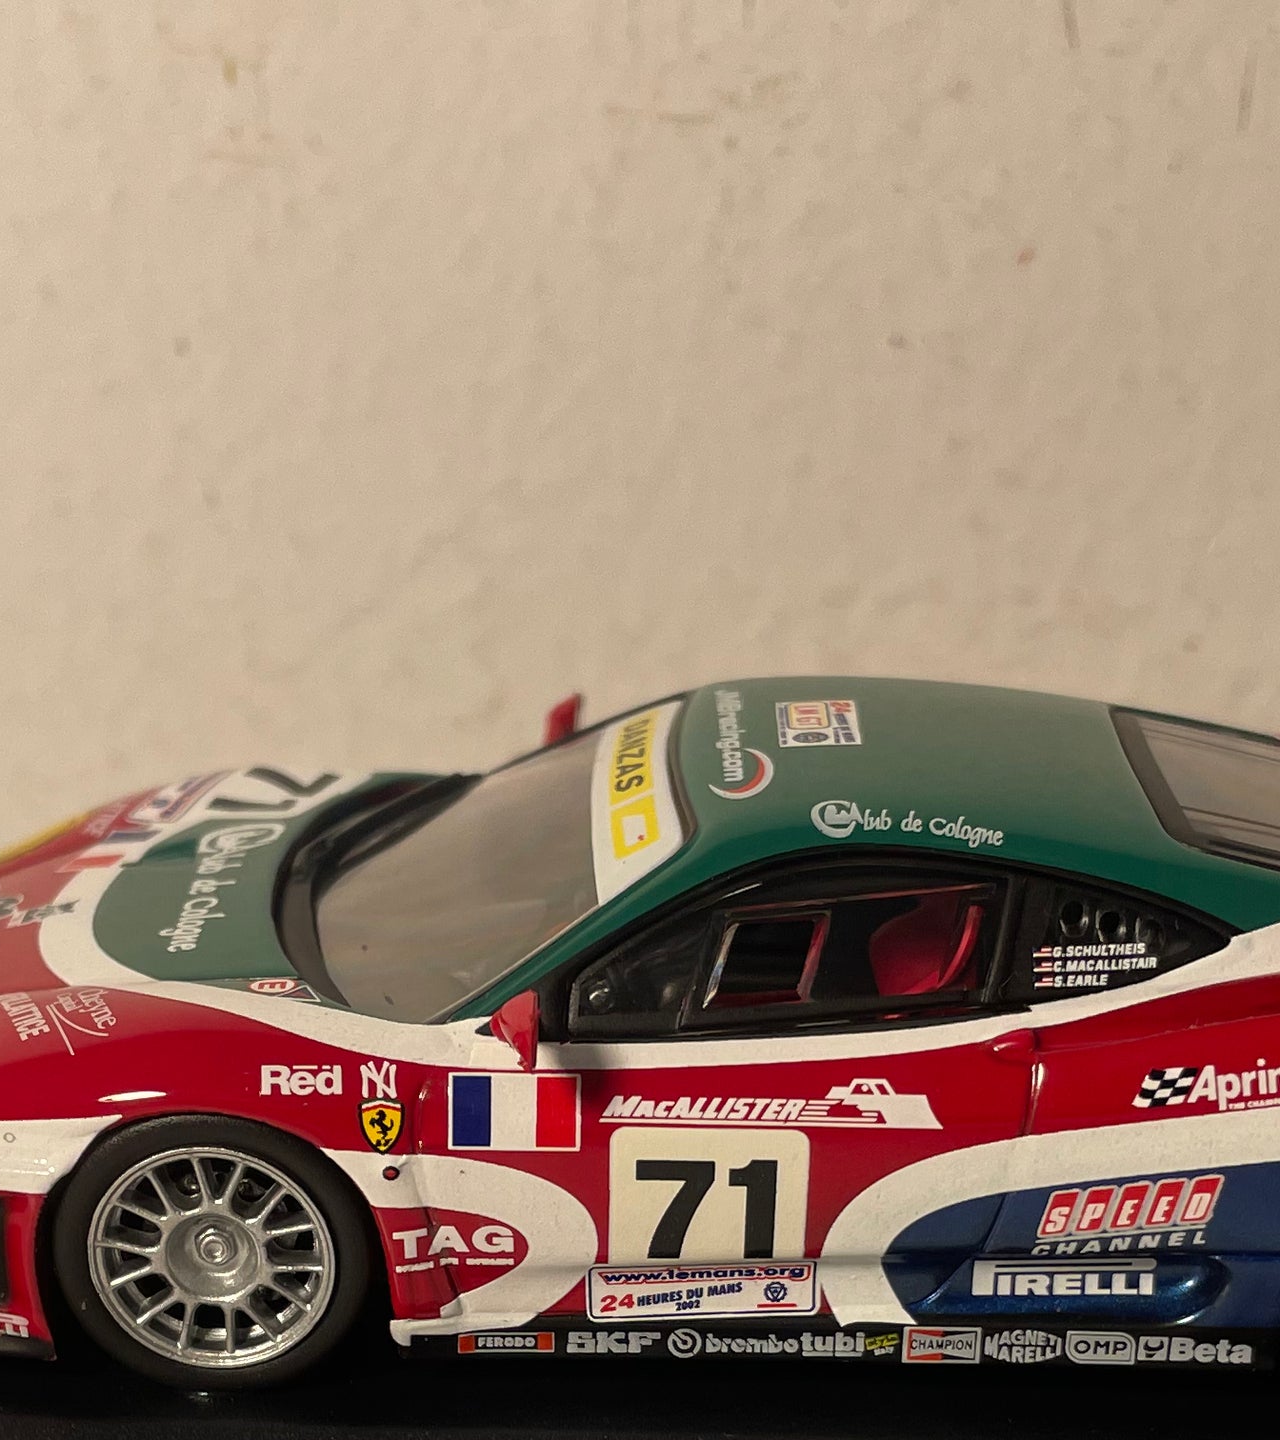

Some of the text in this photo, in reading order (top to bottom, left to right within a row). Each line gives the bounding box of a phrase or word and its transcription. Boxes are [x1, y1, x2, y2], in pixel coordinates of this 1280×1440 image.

[614, 718, 651, 792] DANZAS
[900, 811, 923, 832] de
[929, 807, 1004, 848] Cologne
[158, 897, 226, 952] Cologne
[635, 1159, 778, 1260] 71
[1043, 1190, 1213, 1234] SPEED
[392, 1225, 515, 1260] TAG
[1031, 1231, 1206, 1256] CHANNEL
[603, 1266, 805, 1283] www.lemans.org
[972, 1257, 1157, 1296] PIRELLI
[600, 1282, 743, 1312] 24 HEURES DU MANS
[675, 1299, 700, 1311] 2002
[477, 1336, 536, 1348] FERODO
[566, 1331, 662, 1354] SKF
[705, 1333, 800, 1354] brembo
[800, 1331, 865, 1357] tubi
[910, 1338, 974, 1351] CHAMPION
[984, 1330, 1062, 1349] MAGNETI
[1073, 1338, 1128, 1356] OMP
[1169, 1337, 1252, 1364] Beta
[984, 1345, 1062, 1363] MARELLI
